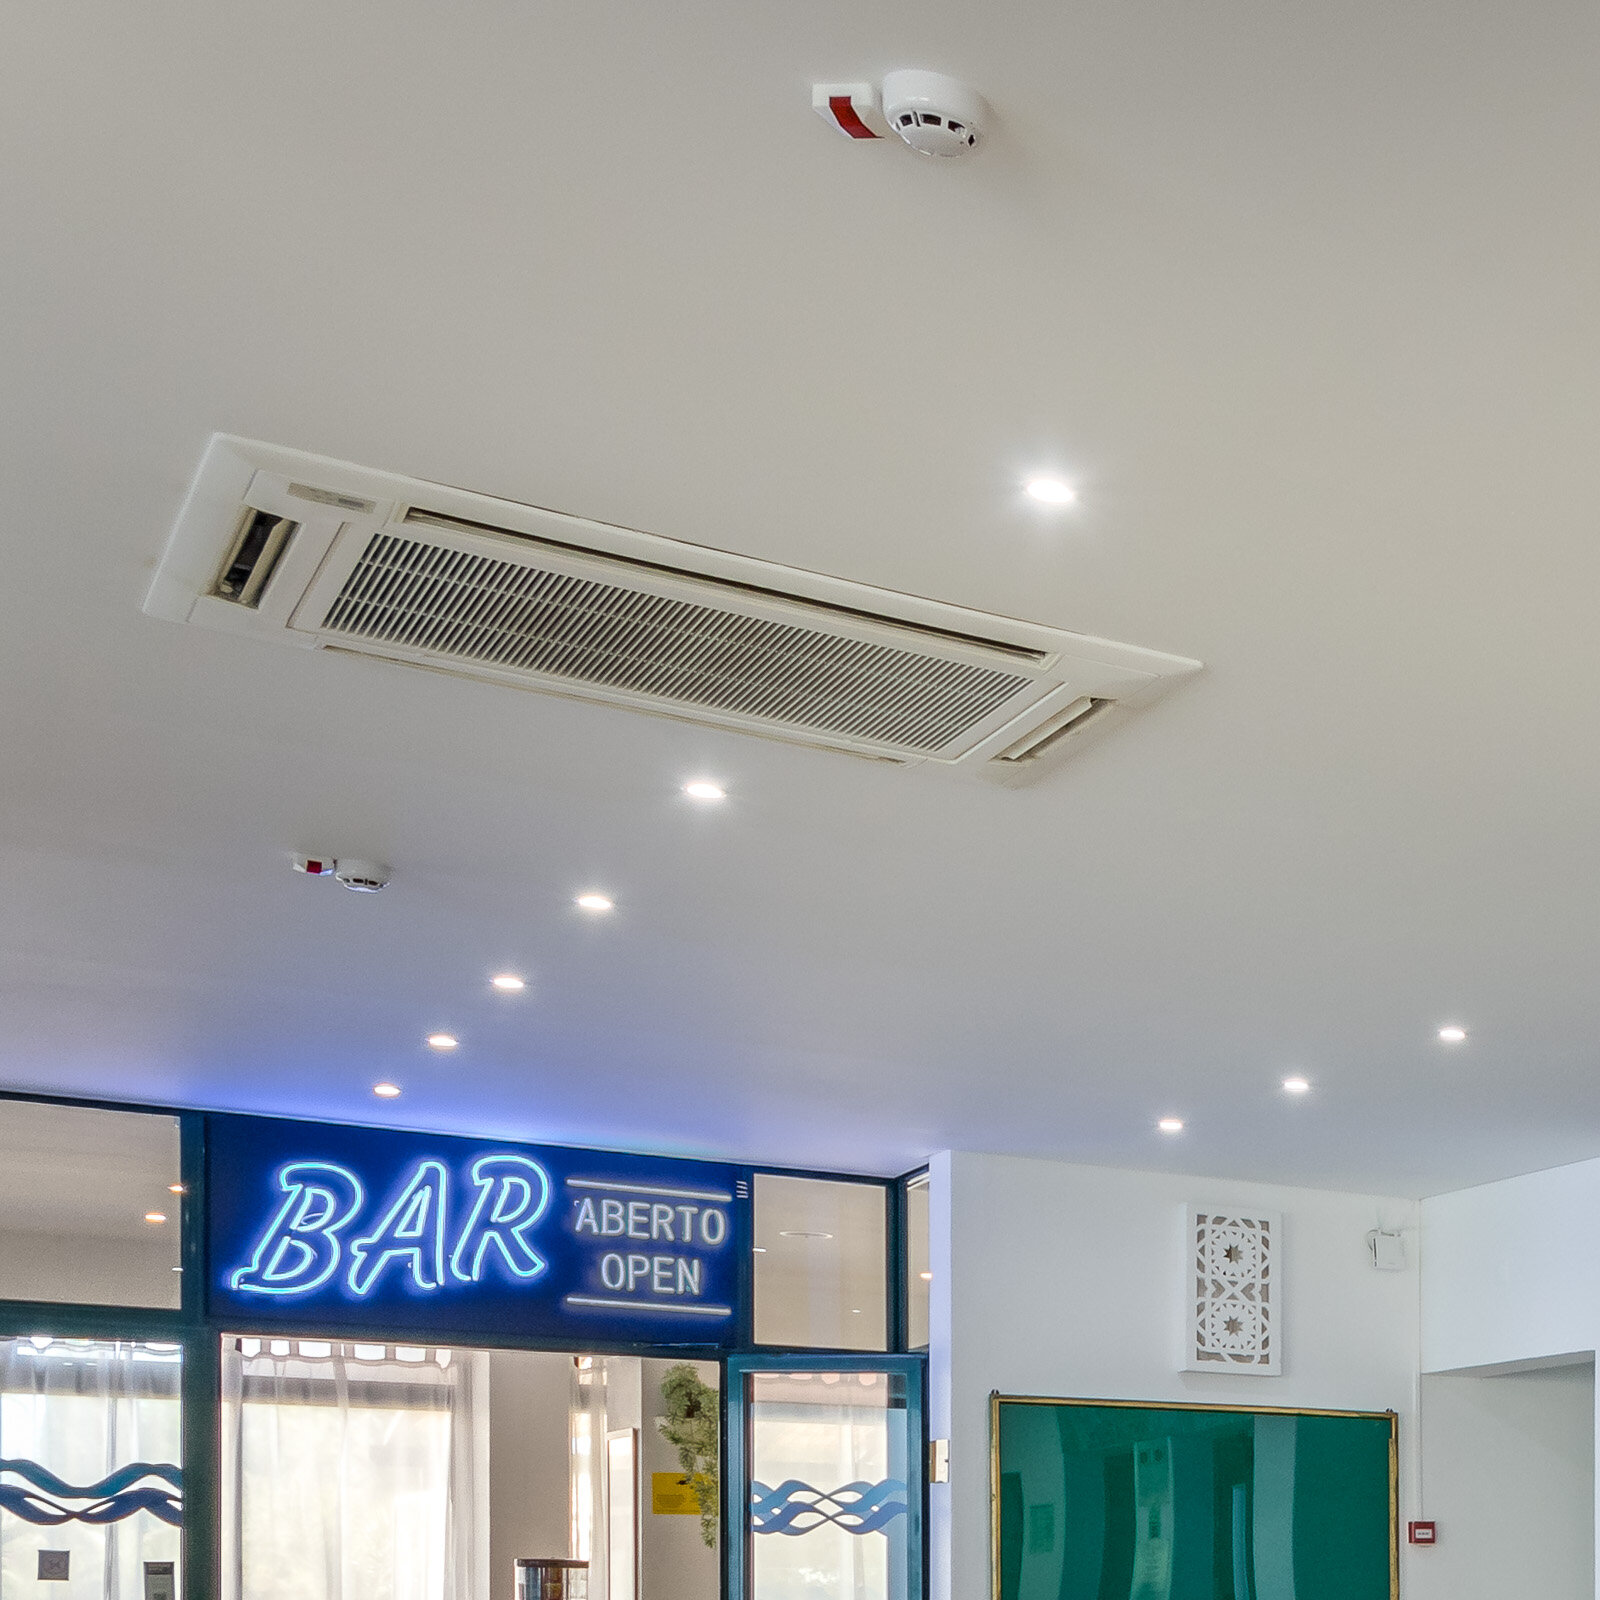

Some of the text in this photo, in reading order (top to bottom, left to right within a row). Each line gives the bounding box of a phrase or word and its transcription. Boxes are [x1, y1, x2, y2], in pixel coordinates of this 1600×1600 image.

[232, 1155, 549, 1294] BAR
[575, 1198, 727, 1246] ABERTO
[600, 1252, 701, 1294] OPEN
